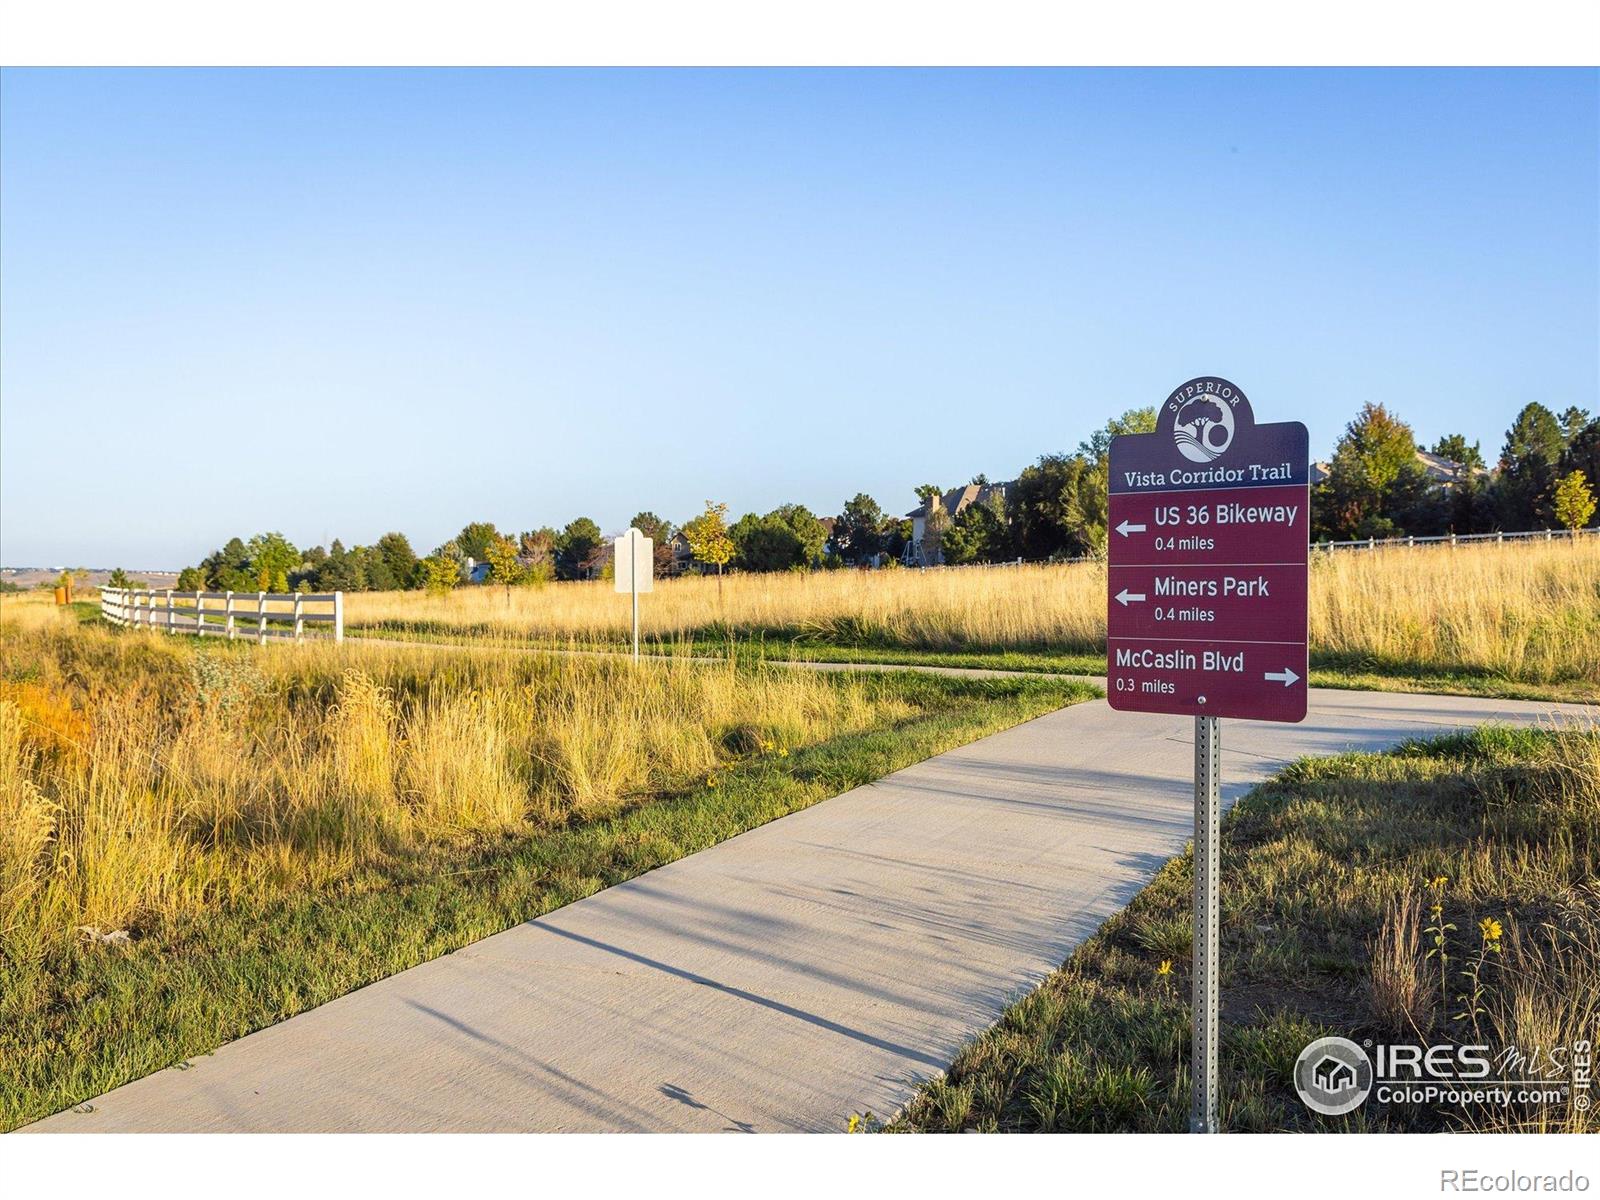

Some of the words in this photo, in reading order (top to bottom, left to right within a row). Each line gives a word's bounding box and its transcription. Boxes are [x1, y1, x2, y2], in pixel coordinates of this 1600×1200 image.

[1170, 382, 1240, 412] SUPERIOR
[1125, 472, 1165, 487] Vista
[1170, 467, 1244, 484] Corridor
[1249, 463, 1292, 480] Trail
[1155, 507, 1180, 525] US
[1186, 506, 1210, 524] 36
[1216, 504, 1298, 526] Bikeway
[1155, 537, 1174, 550] 0.4
[1178, 536, 1214, 550] miles
[1154, 576, 1218, 596] Miners
[1224, 576, 1269, 596] Park
[1154, 608, 1174, 620] 0.4
[1178, 608, 1214, 621] miles
[1116, 648, 1196, 670] McCaslin
[1203, 652, 1244, 672] Blvd
[1116, 678, 1135, 692] 0.3
[1142, 680, 1174, 694] miles
